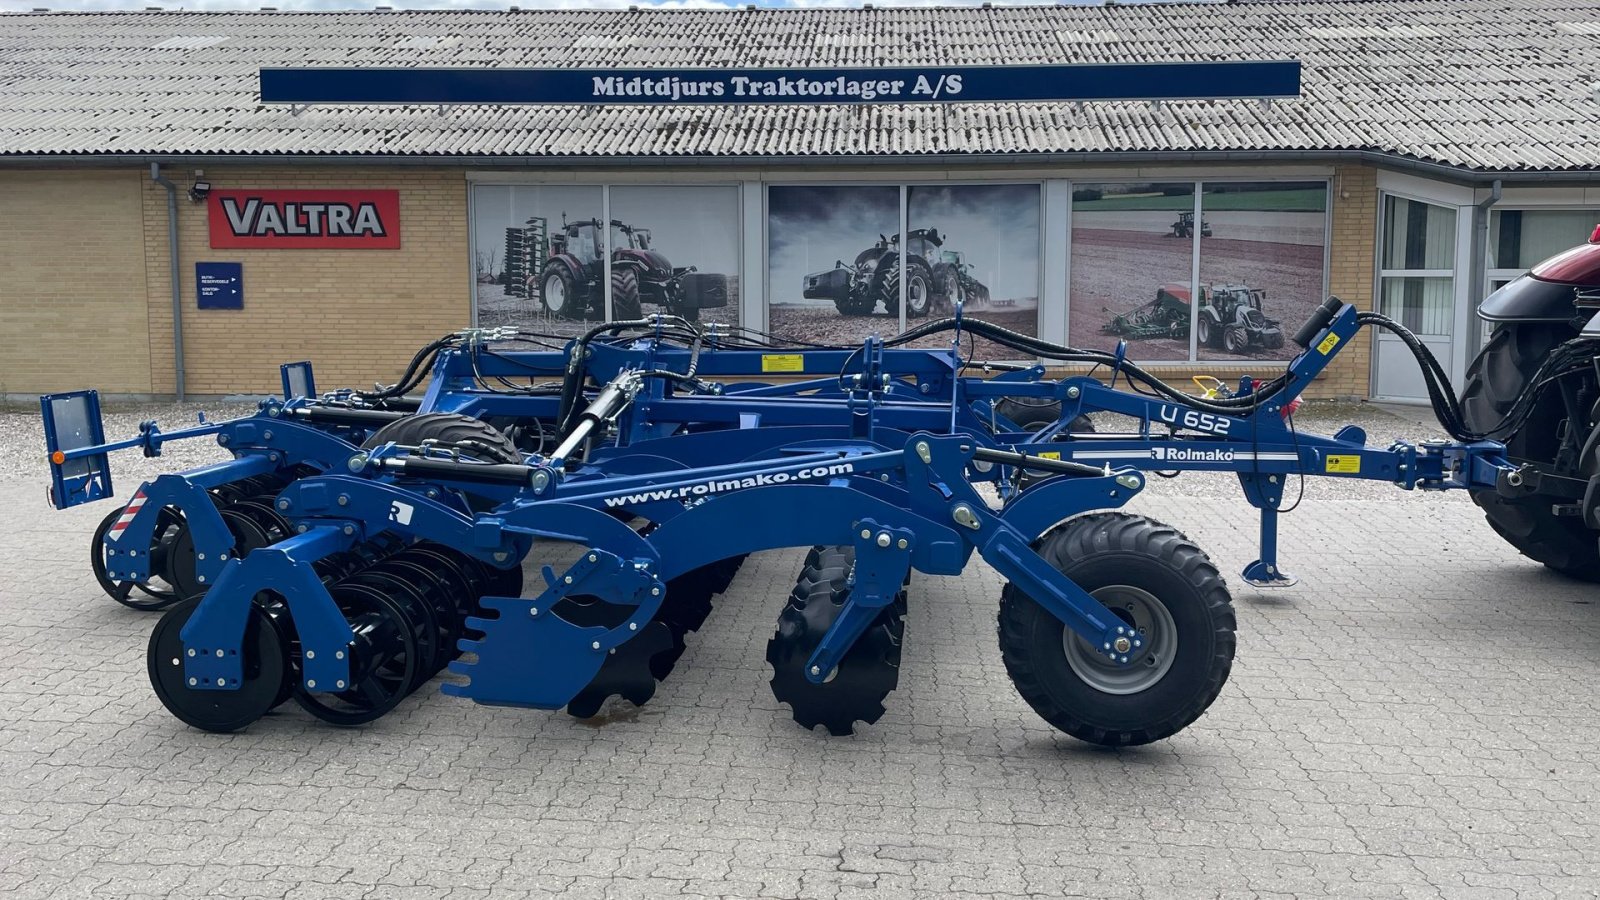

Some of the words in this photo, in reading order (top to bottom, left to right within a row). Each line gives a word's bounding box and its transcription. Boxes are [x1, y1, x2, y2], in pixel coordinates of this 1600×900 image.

[592, 76, 724, 100] Midtdjurs
[731, 76, 905, 99] Traktorlager
[912, 74, 963, 98] A/S
[221, 198, 387, 237] VALTRA
[1160, 404, 1178, 423] U
[1184, 411, 1231, 435] 652
[1166, 448, 1234, 461] Rolmako
[604, 463, 853, 508] www.rolmako.com
